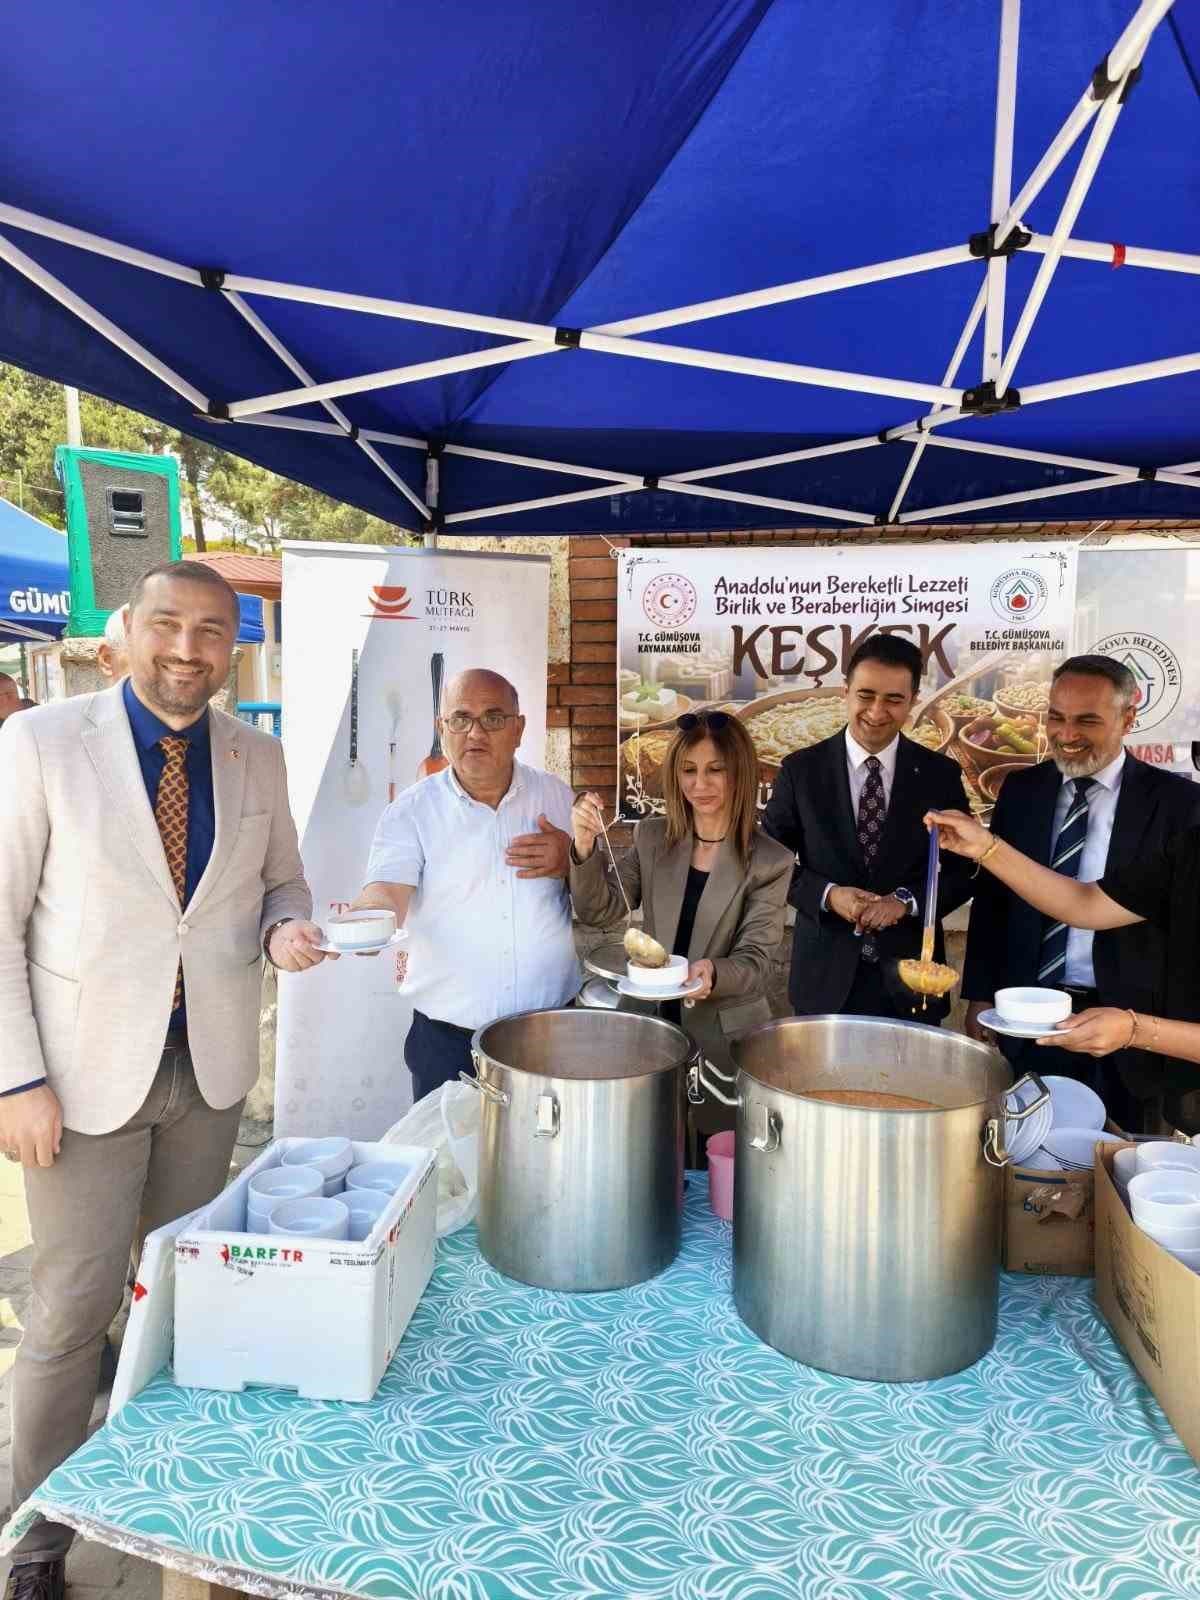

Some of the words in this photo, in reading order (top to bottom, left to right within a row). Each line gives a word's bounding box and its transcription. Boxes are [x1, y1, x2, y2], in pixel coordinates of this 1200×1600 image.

[714, 576, 821, 595] Anadolu'nun
[826, 575, 903, 595] Bereketli
[908, 574, 969, 595] Lezzeti
[9, 586, 71, 616] GÜMÜ
[425, 588, 473, 606] TÜRK
[715, 596, 761, 615] Birlik
[766, 601, 786, 614] ve
[791, 595, 896, 622] Beraberliğin
[901, 595, 969, 621] Simgesi
[638, 632, 653, 642] T.C.
[654, 631, 701, 643] GÜMÜŞOVA
[985, 630, 1000, 640] T.C.
[1002, 629, 1050, 641] GÜMÜŞOVA
[638, 642, 701, 654] KAYMAKAMLIĞI
[970, 640, 1010, 651] BELEDİYE
[1012, 639, 1064, 652] BAŞKANLIĞI
[731, 622, 957, 689] KEŞKK
